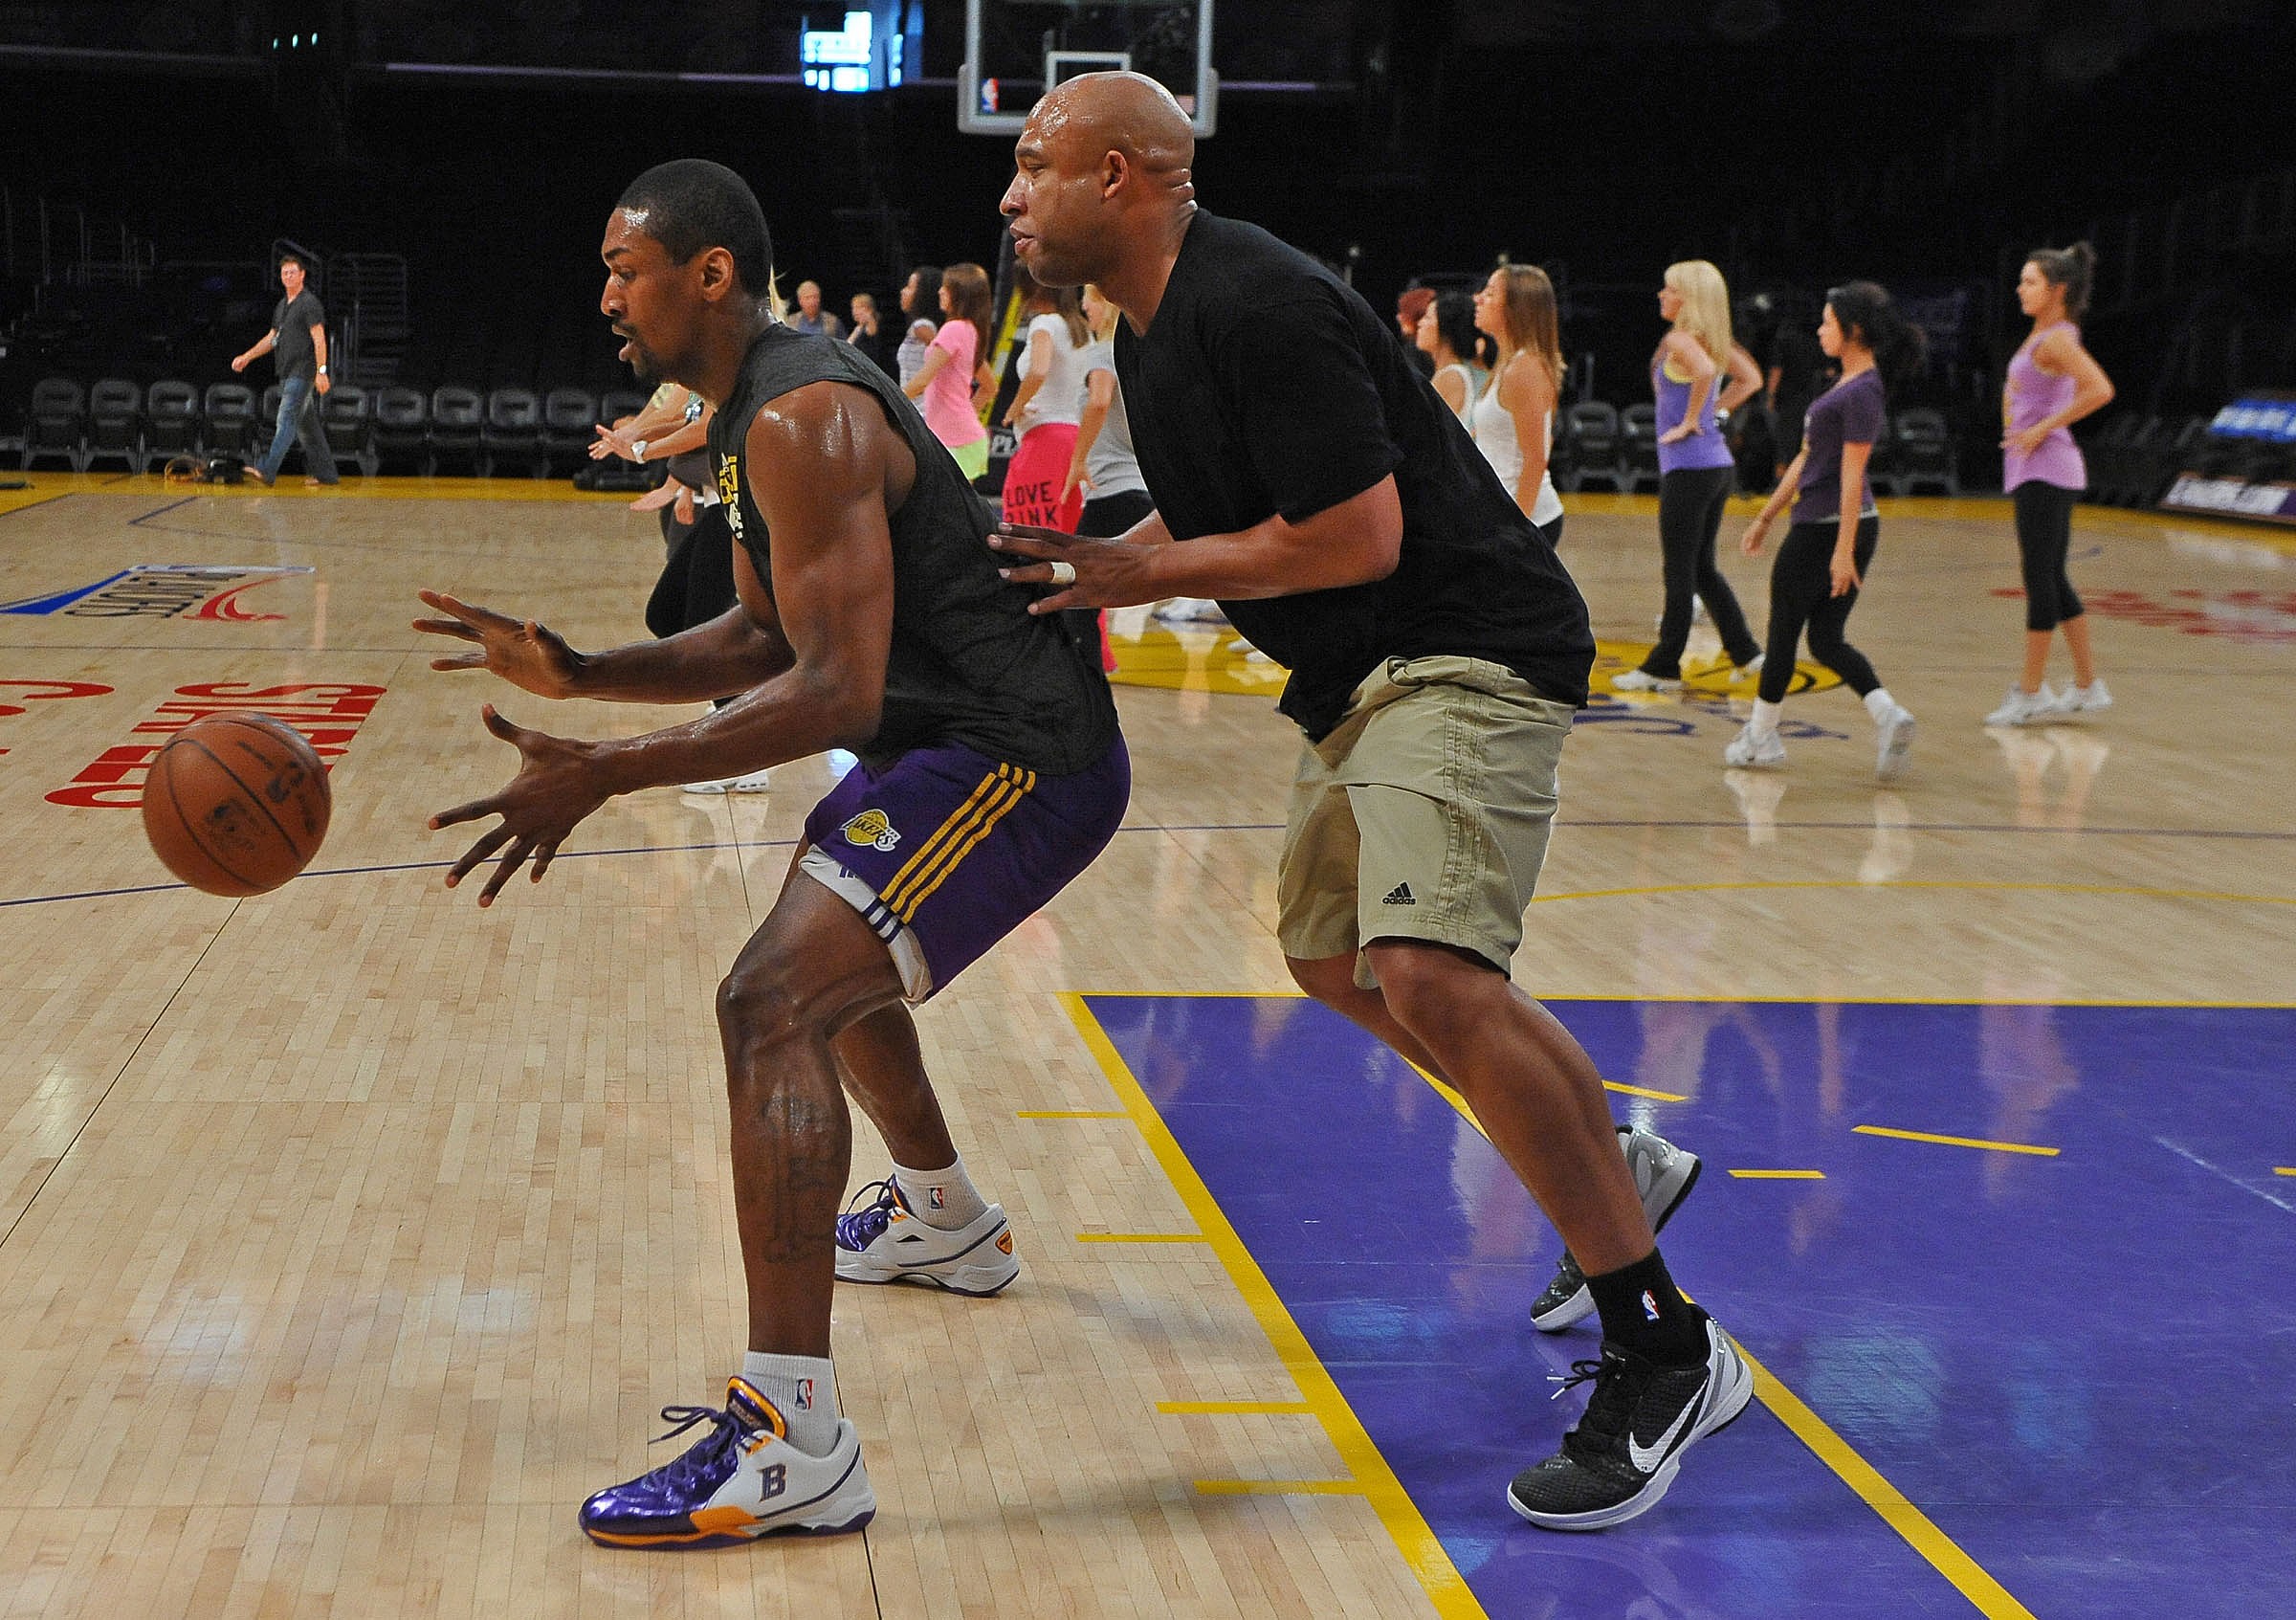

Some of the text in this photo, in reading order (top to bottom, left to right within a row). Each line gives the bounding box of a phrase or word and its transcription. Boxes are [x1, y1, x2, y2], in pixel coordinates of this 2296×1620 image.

[1005, 480, 1053, 507] LOVE
[1381, 897, 1417, 905] adidas
[756, 1463, 787, 1503] B
